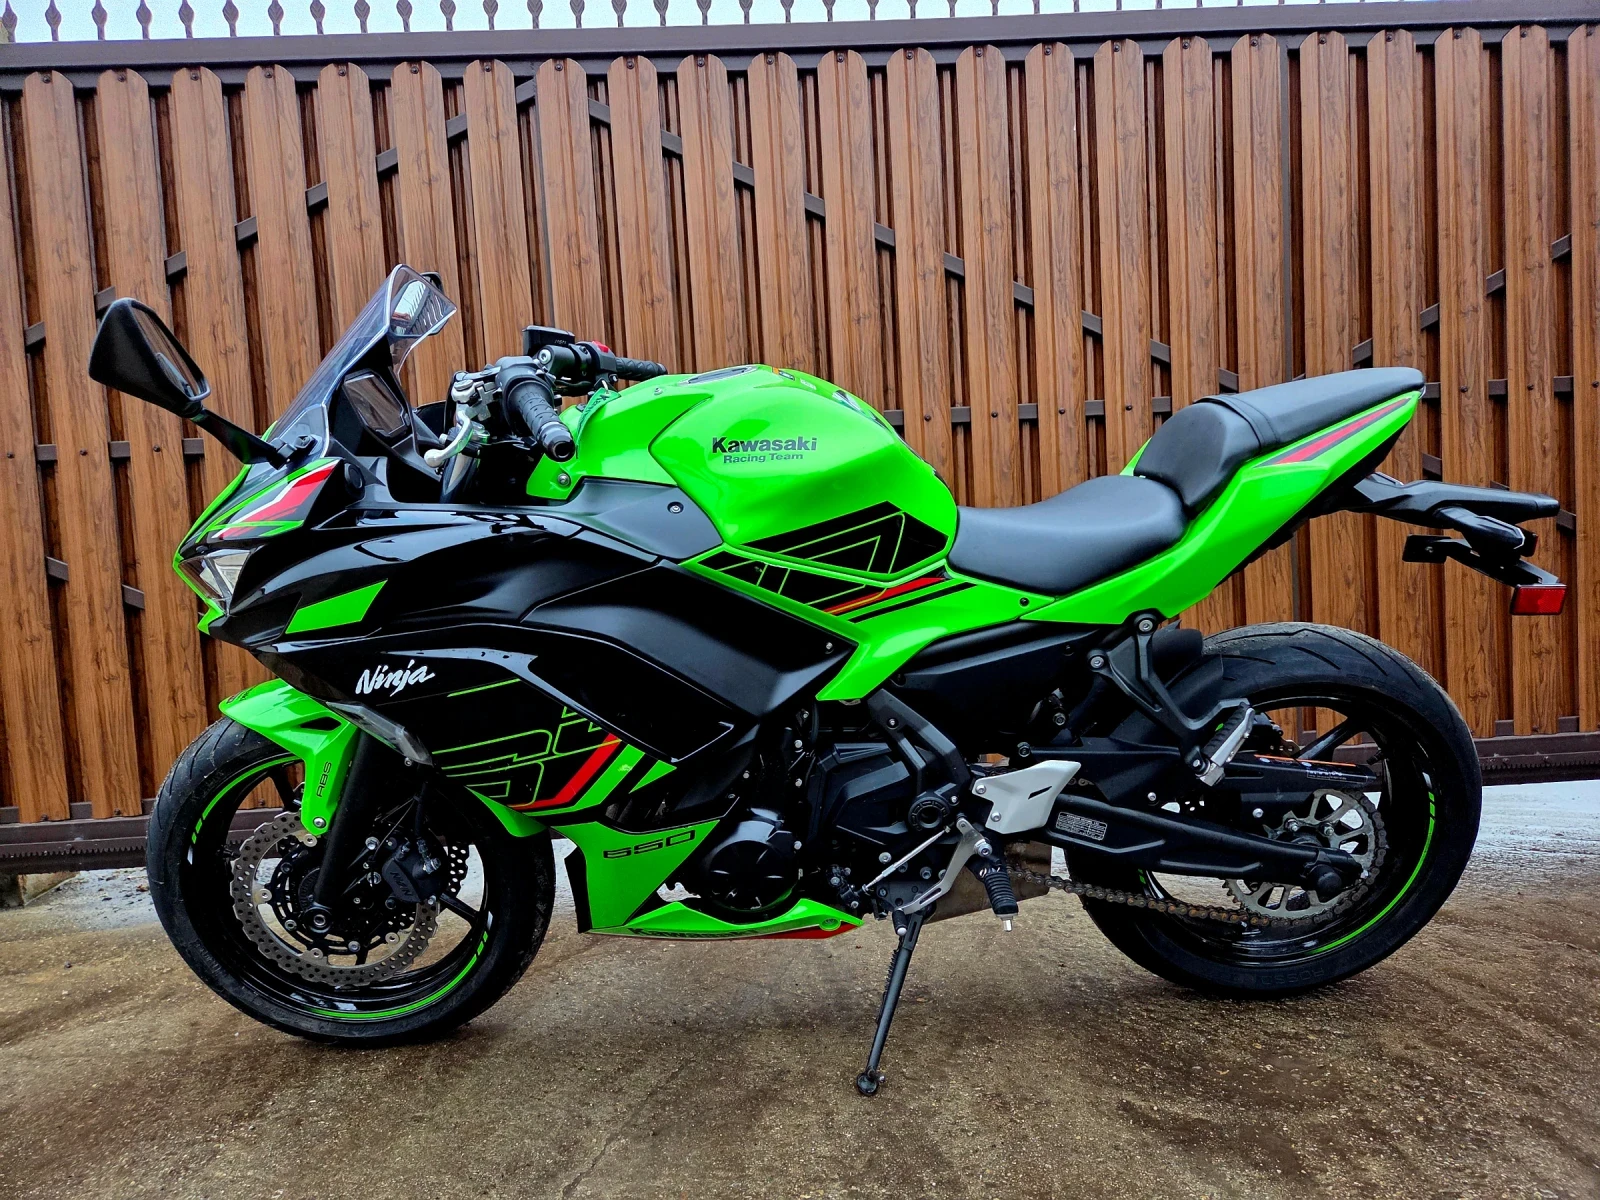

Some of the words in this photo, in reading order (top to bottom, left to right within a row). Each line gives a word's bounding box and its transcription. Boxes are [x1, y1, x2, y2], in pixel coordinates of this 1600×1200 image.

[712, 436, 817, 453] Kawasaki
[723, 454, 766, 464] Racing
[769, 452, 804, 461] Team
[355, 659, 436, 697] Ninja
[316, 761, 332, 798] ABS
[603, 830, 696, 859] 650
